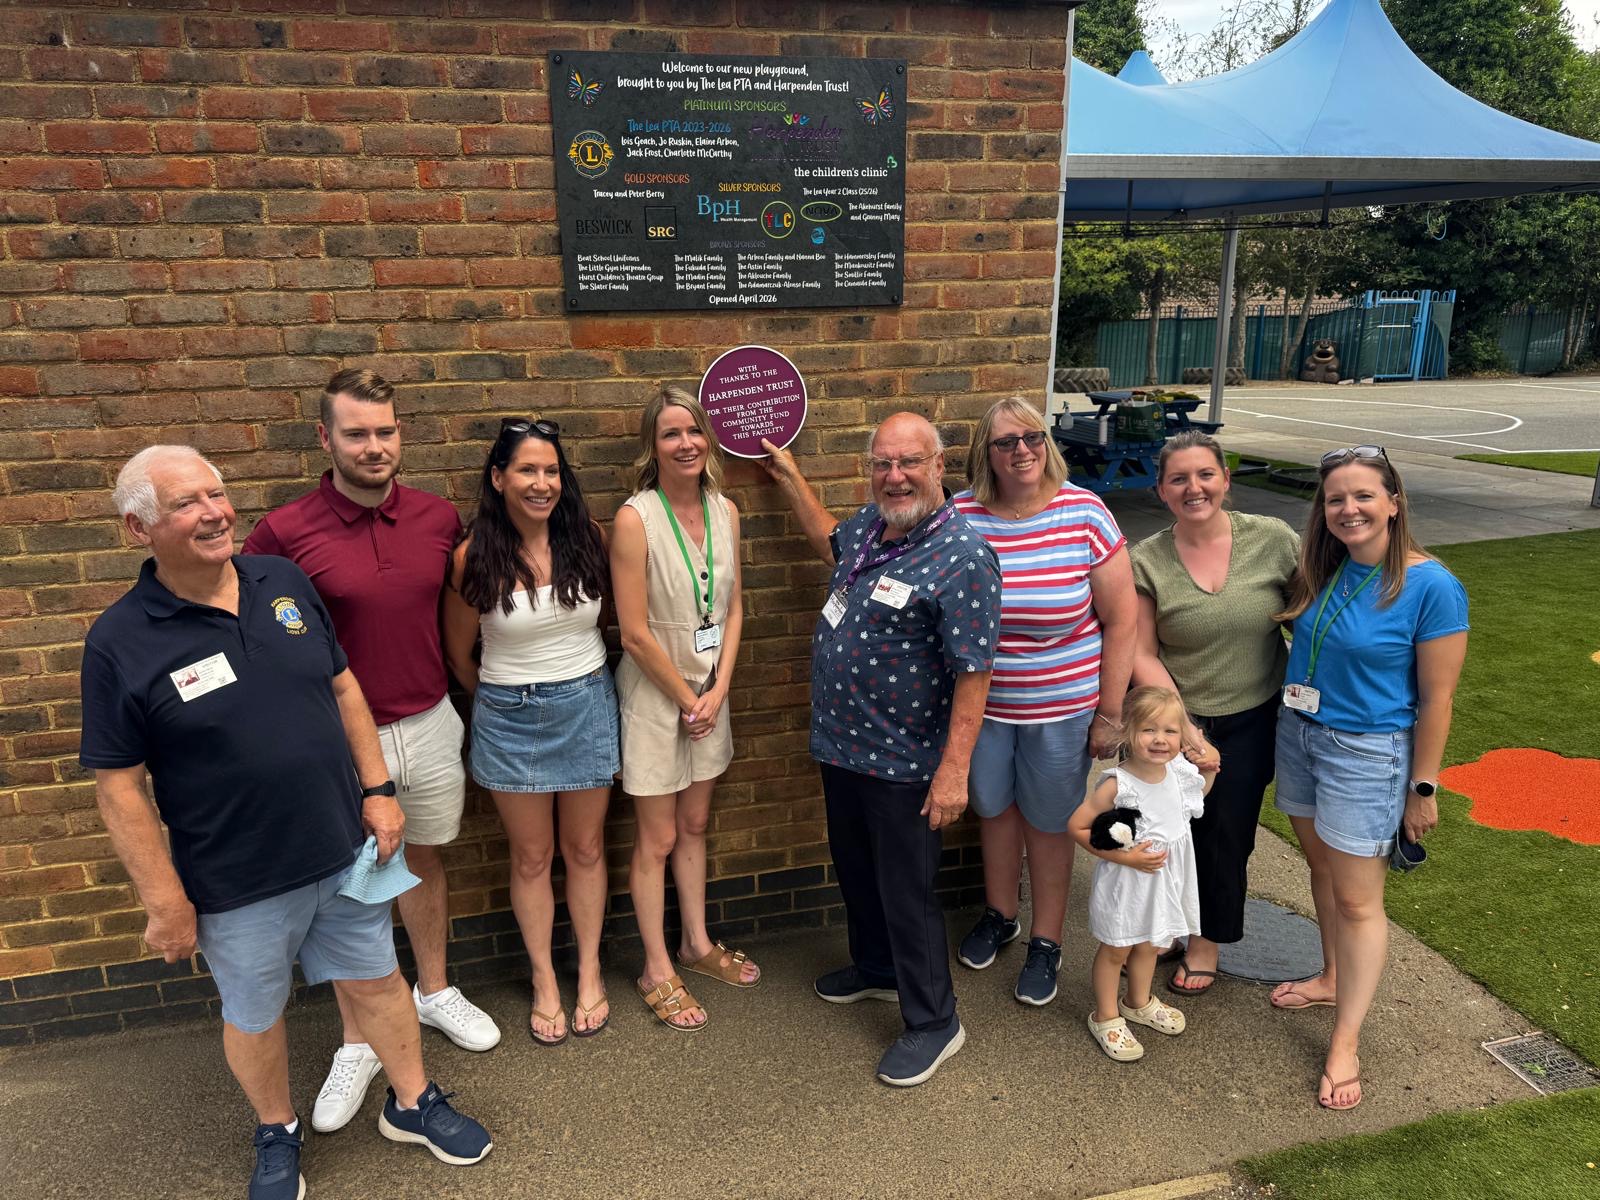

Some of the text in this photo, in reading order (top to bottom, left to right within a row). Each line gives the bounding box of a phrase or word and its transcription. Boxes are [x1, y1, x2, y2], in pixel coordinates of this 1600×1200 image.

[662, 61, 809, 77] Welcome to our new playground,
[617, 75, 849, 93] brought to you by The Lea PTA and Harpenden Trust!
[684, 99, 787, 112] PLATINUM SPONSORS
[627, 119, 732, 133] The Lea PTA 2023-2026
[621, 136, 740, 147] Lois Geach, Jo Ruskin, Elaine Arbon,
[585, 145, 599, 162] L
[626, 148, 733, 160] Jack Frost, Charlotte McCarthy
[794, 167, 888, 177] the children's clinic
[624, 173, 690, 184] GOLD SPONSORS
[718, 182, 782, 193] SILVER SPONSORS
[803, 187, 812, 196] The
[813, 187, 822, 195] Lea
[823, 188, 837, 197] Year
[842, 187, 858, 196] Class
[858, 187, 879, 196] (25/26)
[593, 189, 665, 200] Tracey and Peter Berry
[848, 202, 858, 211] The
[858, 202, 883, 211] Akehurst
[850, 213, 862, 221] and
[883, 213, 901, 222] Mary
[575, 219, 634, 235] BESWICK
[648, 226, 676, 238] SRC
[593, 254, 613, 262] School
[674, 254, 684, 263] The
[704, 254, 724, 263] Family
[737, 253, 747, 261] The
[765, 253, 784, 262] Family
[877, 252, 896, 261] Family
[578, 264, 652, 273] The Little Gym Harpenden
[675, 264, 684, 272] The
[707, 264, 727, 273] Family
[737, 263, 747, 271] The
[764, 263, 783, 272] Family
[835, 262, 843, 270] The
[876, 261, 895, 270] Family
[626, 273, 646, 281] Theatre
[646, 274, 664, 283] Group
[675, 274, 684, 282] The
[706, 273, 726, 282] Family
[737, 272, 747, 280] The
[772, 272, 792, 281] Family
[835, 271, 843, 279] The
[579, 283, 589, 291] The
[608, 282, 629, 292] Family
[706, 282, 726, 290] Family
[738, 281, 747, 290] The
[802, 280, 821, 289] Family
[835, 280, 844, 288] The
[868, 279, 887, 288] Family
[709, 294, 778, 305] Opened April 2026
[738, 365, 758, 374] WITH
[720, 374, 750, 384] THANKS
[763, 369, 778, 377] THE
[708, 380, 794, 402] HARPENDEN TRUST
[707, 394, 801, 417] FOR THEIR CONTRIBUTION
[737, 406, 774, 419] FROM THE
[722, 411, 790, 428] COMMUNITY FUND
[741, 421, 774, 432] TOWARDS
[733, 426, 785, 440] THIS FACILITY
[286, 609, 297, 620] L
